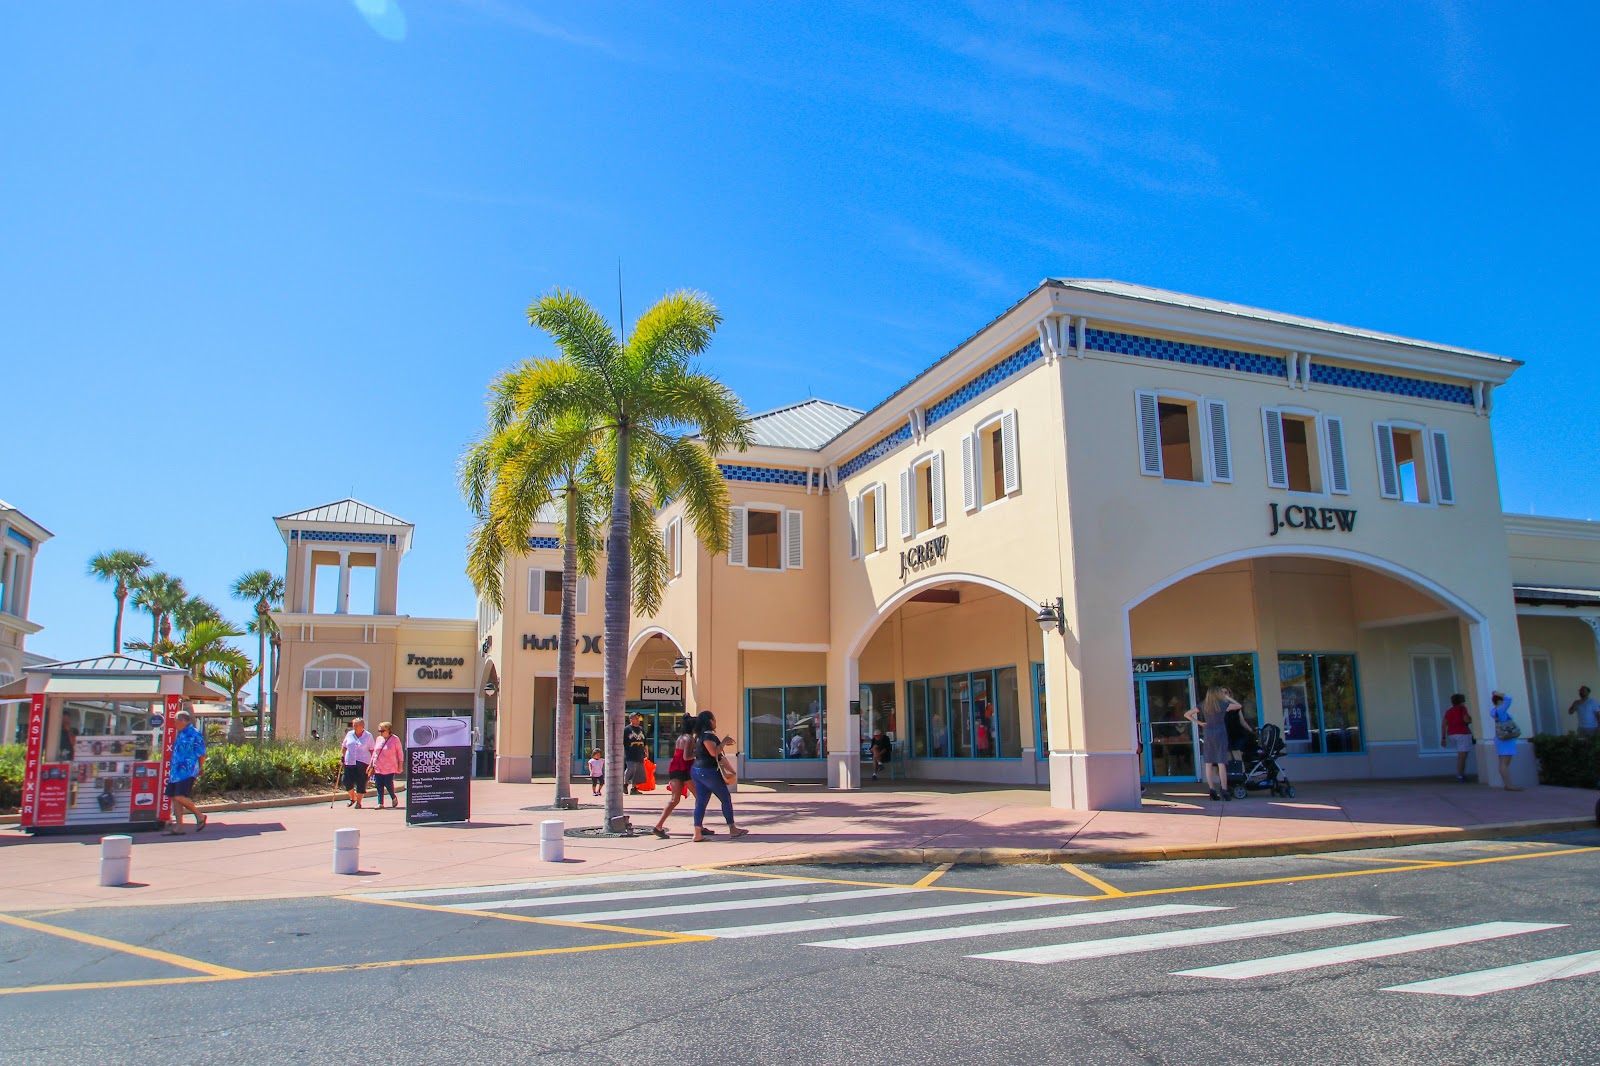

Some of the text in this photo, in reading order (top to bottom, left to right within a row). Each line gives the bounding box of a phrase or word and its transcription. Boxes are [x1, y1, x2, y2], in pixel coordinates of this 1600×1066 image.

[1269, 502, 1358, 537] J.CREW
[898, 534, 948, 580] J.CREW
[407, 653, 465, 668] Fragrance
[417, 667, 453, 680] Outlet
[643, 685, 671, 695] Hurley
[31, 703, 41, 745] FAST
[162, 703, 177, 811] WE FIX PHOES
[412, 750, 446, 760] SPRING
[412, 757, 457, 767] CONCERT
[412, 765, 441, 774] SERIES
[24, 760, 37, 813] FIXER
